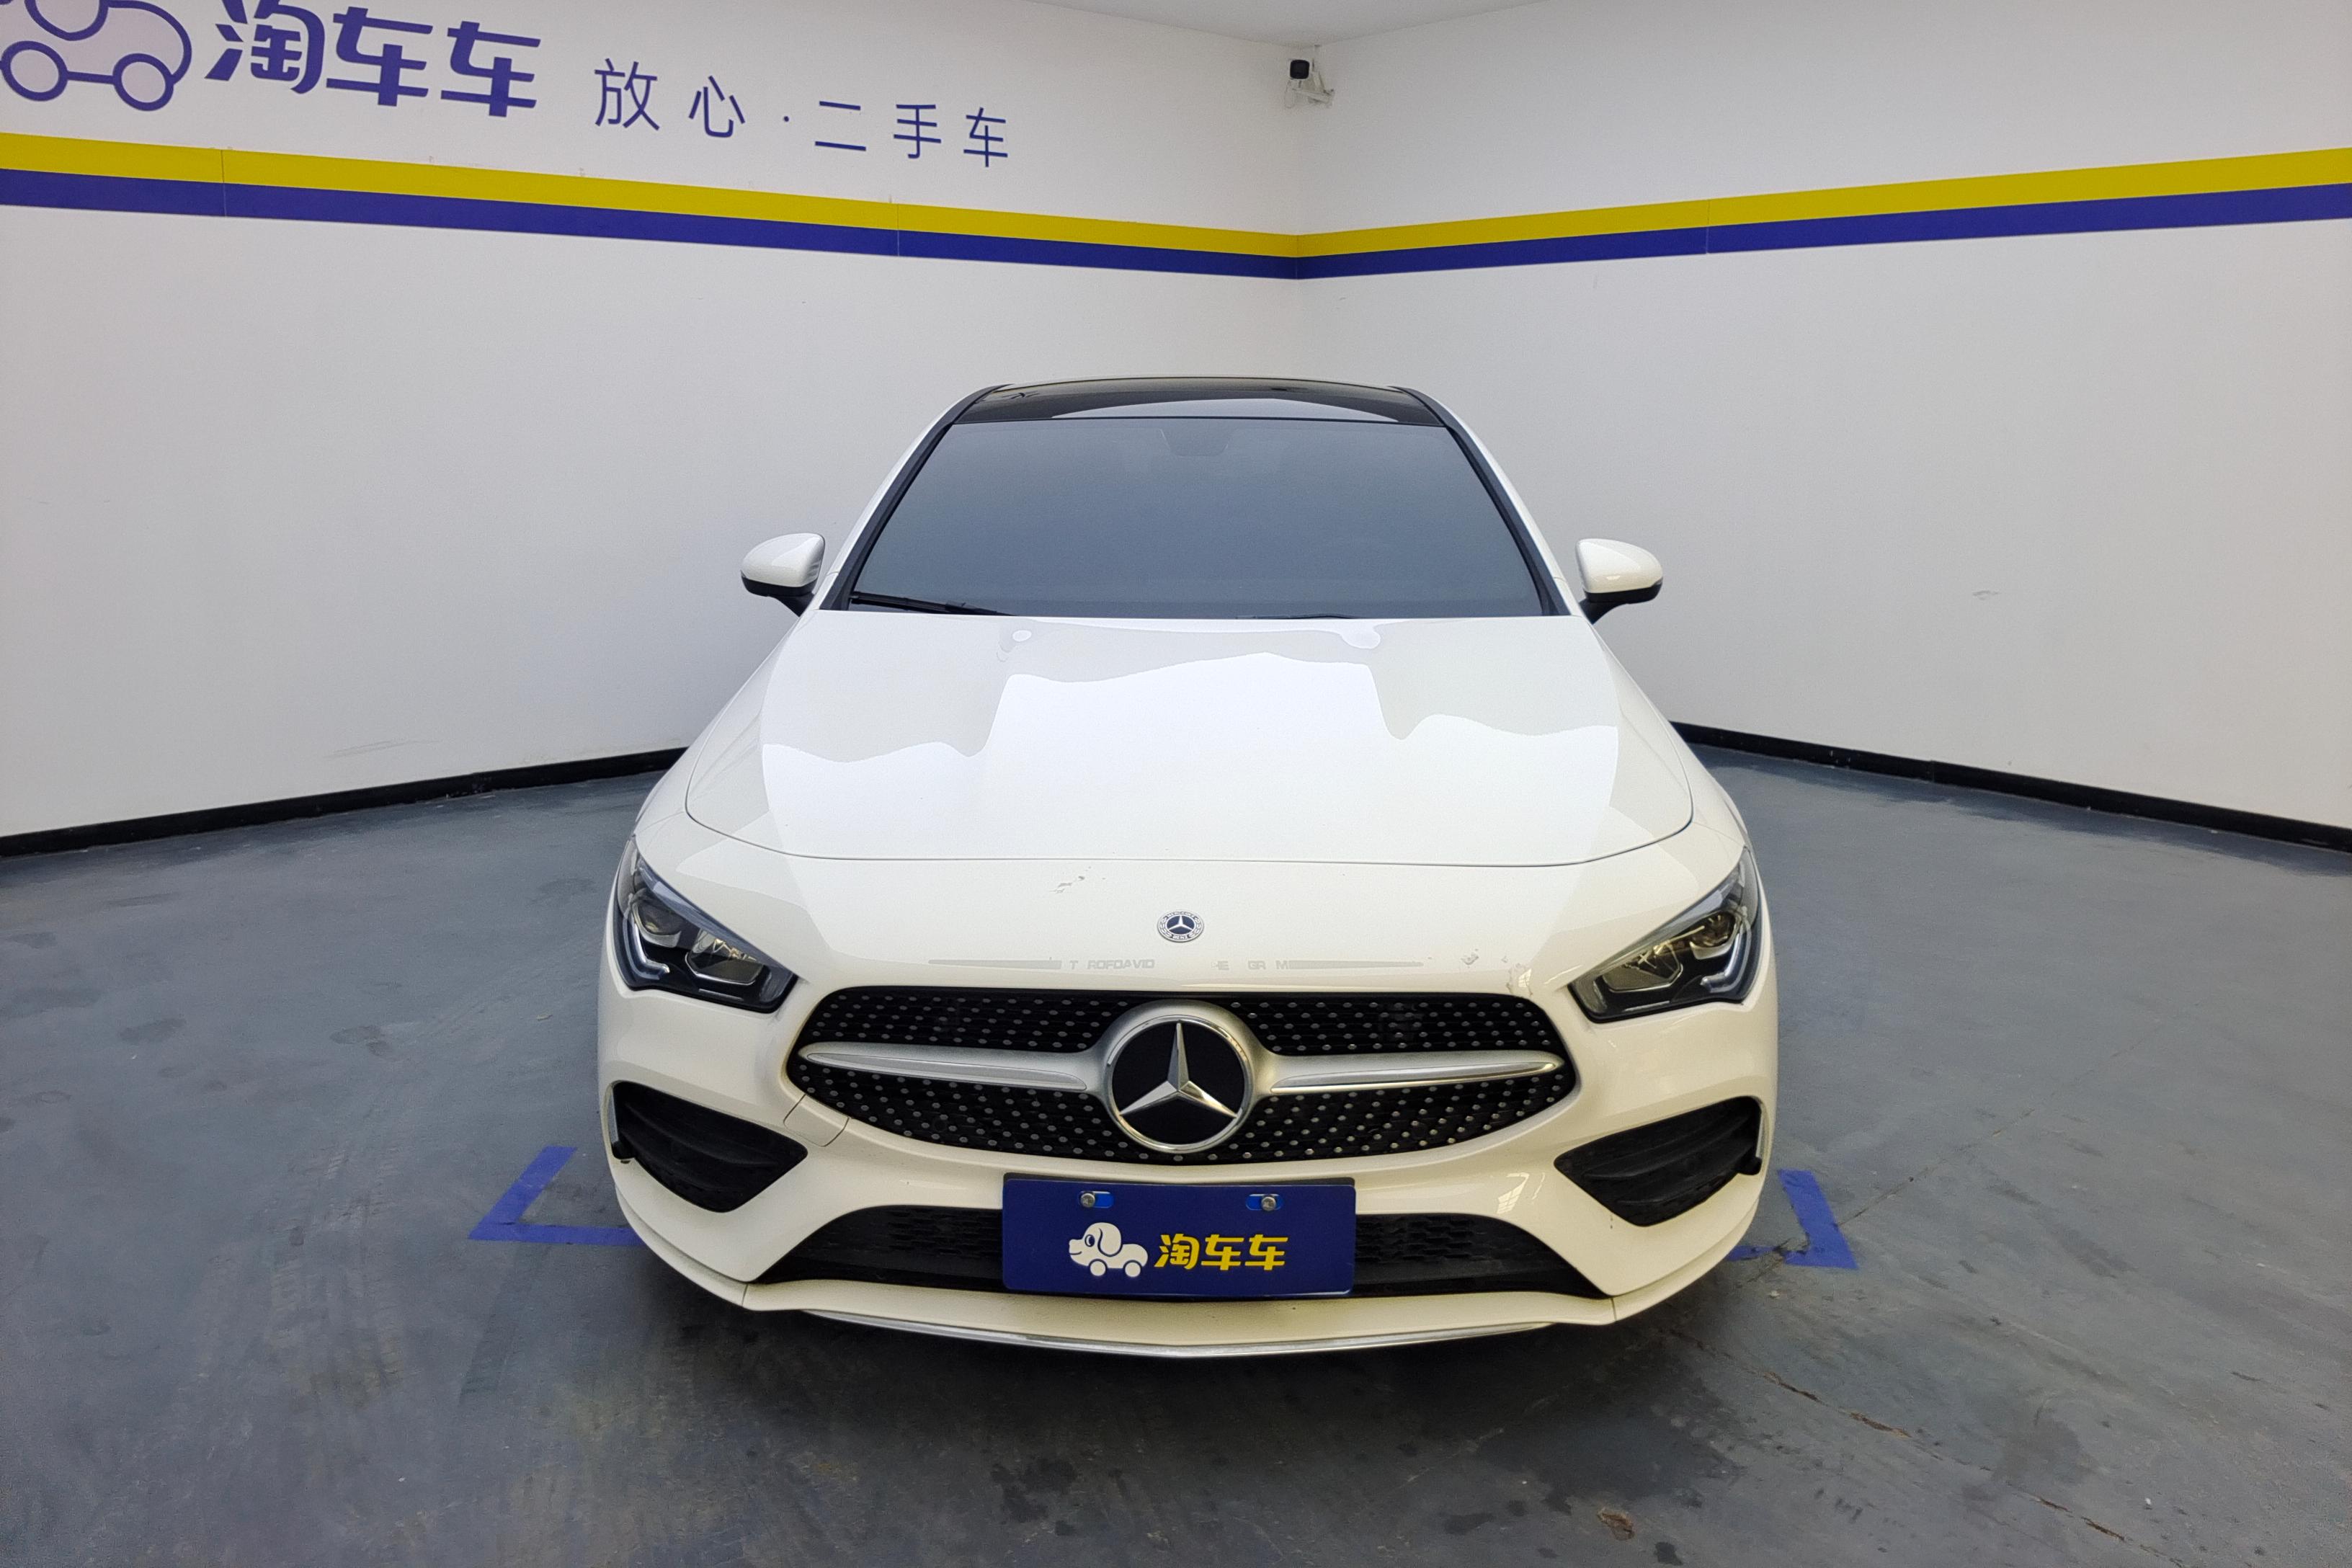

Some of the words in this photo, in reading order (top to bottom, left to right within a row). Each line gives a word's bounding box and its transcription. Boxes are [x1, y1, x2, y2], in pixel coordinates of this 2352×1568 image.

[205, 0, 540, 117] 淘车车
[1154, 1234, 1288, 1270] 淘车车
